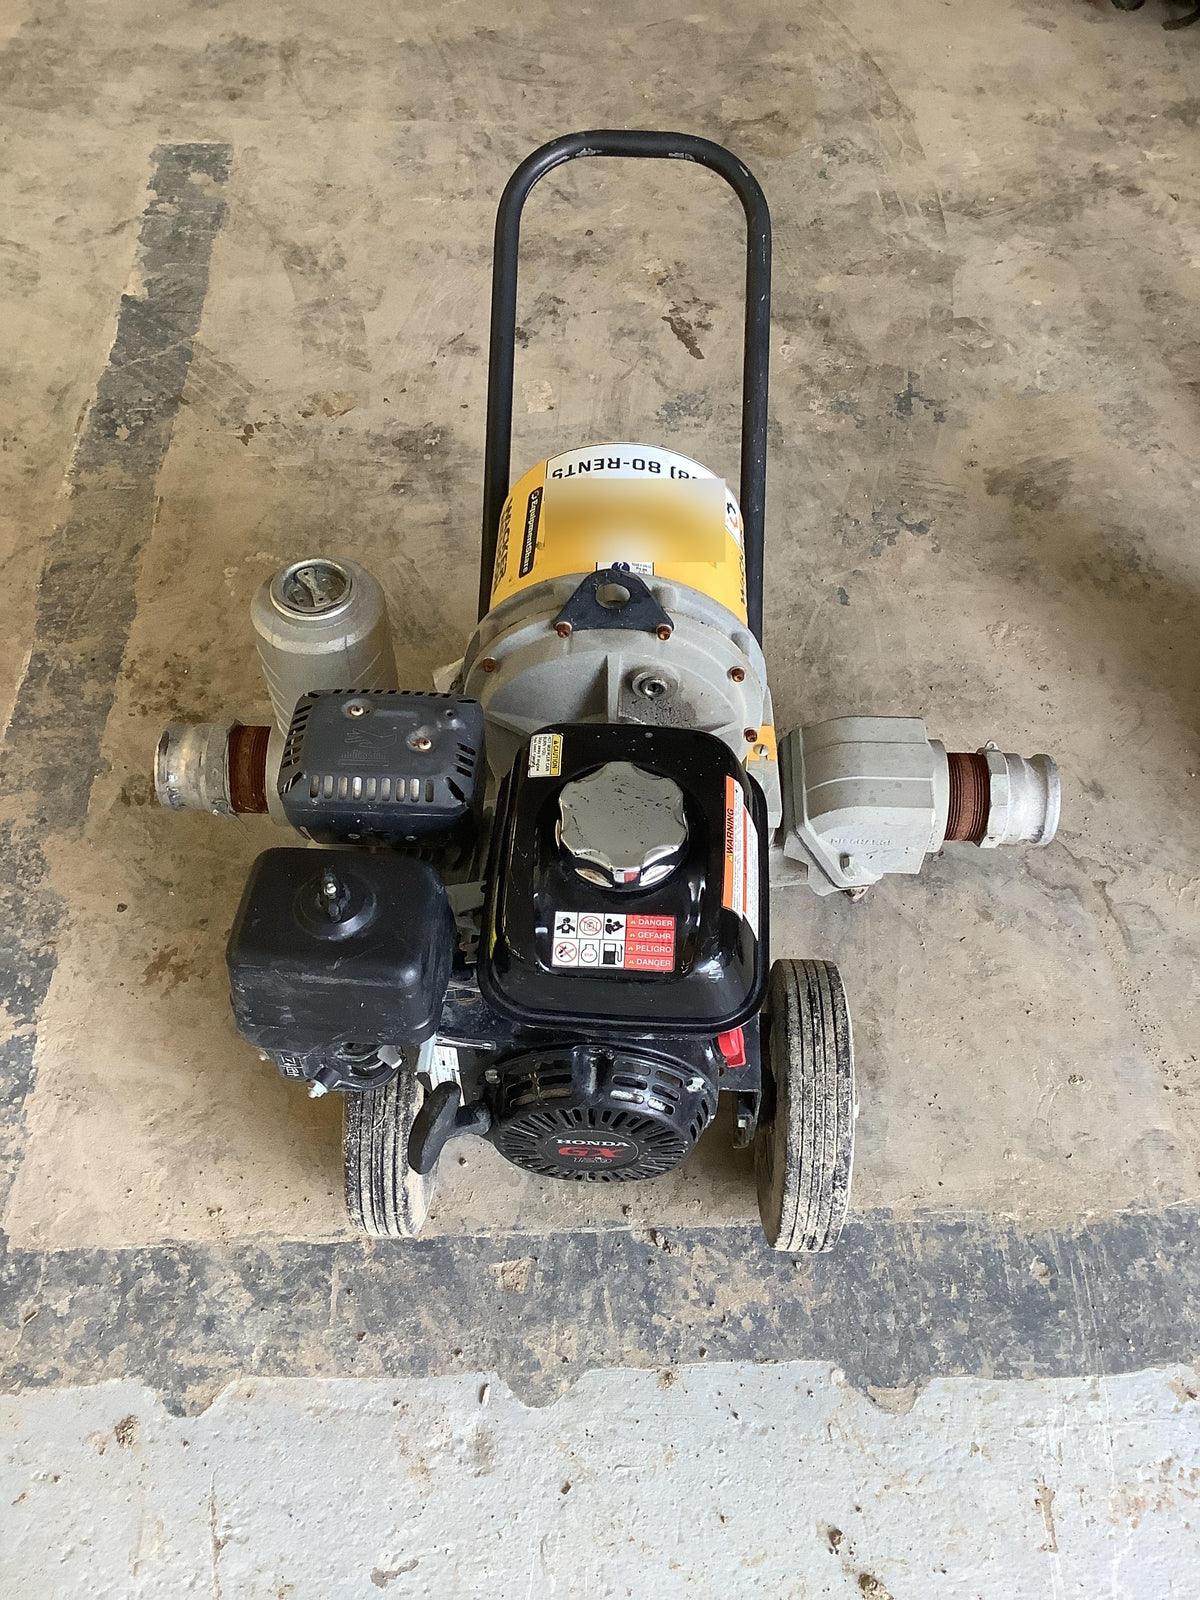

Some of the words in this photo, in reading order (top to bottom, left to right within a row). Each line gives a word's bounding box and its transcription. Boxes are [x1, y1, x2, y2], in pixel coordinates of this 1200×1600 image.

[552, 457, 661, 479] 80-RENTS
[523, 499, 539, 573] EquipmentShare
[726, 808, 734, 854] WARNING
[638, 918, 673, 927] DANGER
[637, 931, 671, 940] GEFAHR
[636, 944, 672, 953] PELIGRO
[636, 957, 671, 966] DANGER
[556, 1138, 631, 1147] HONDA
[558, 1146, 623, 1158] GX
